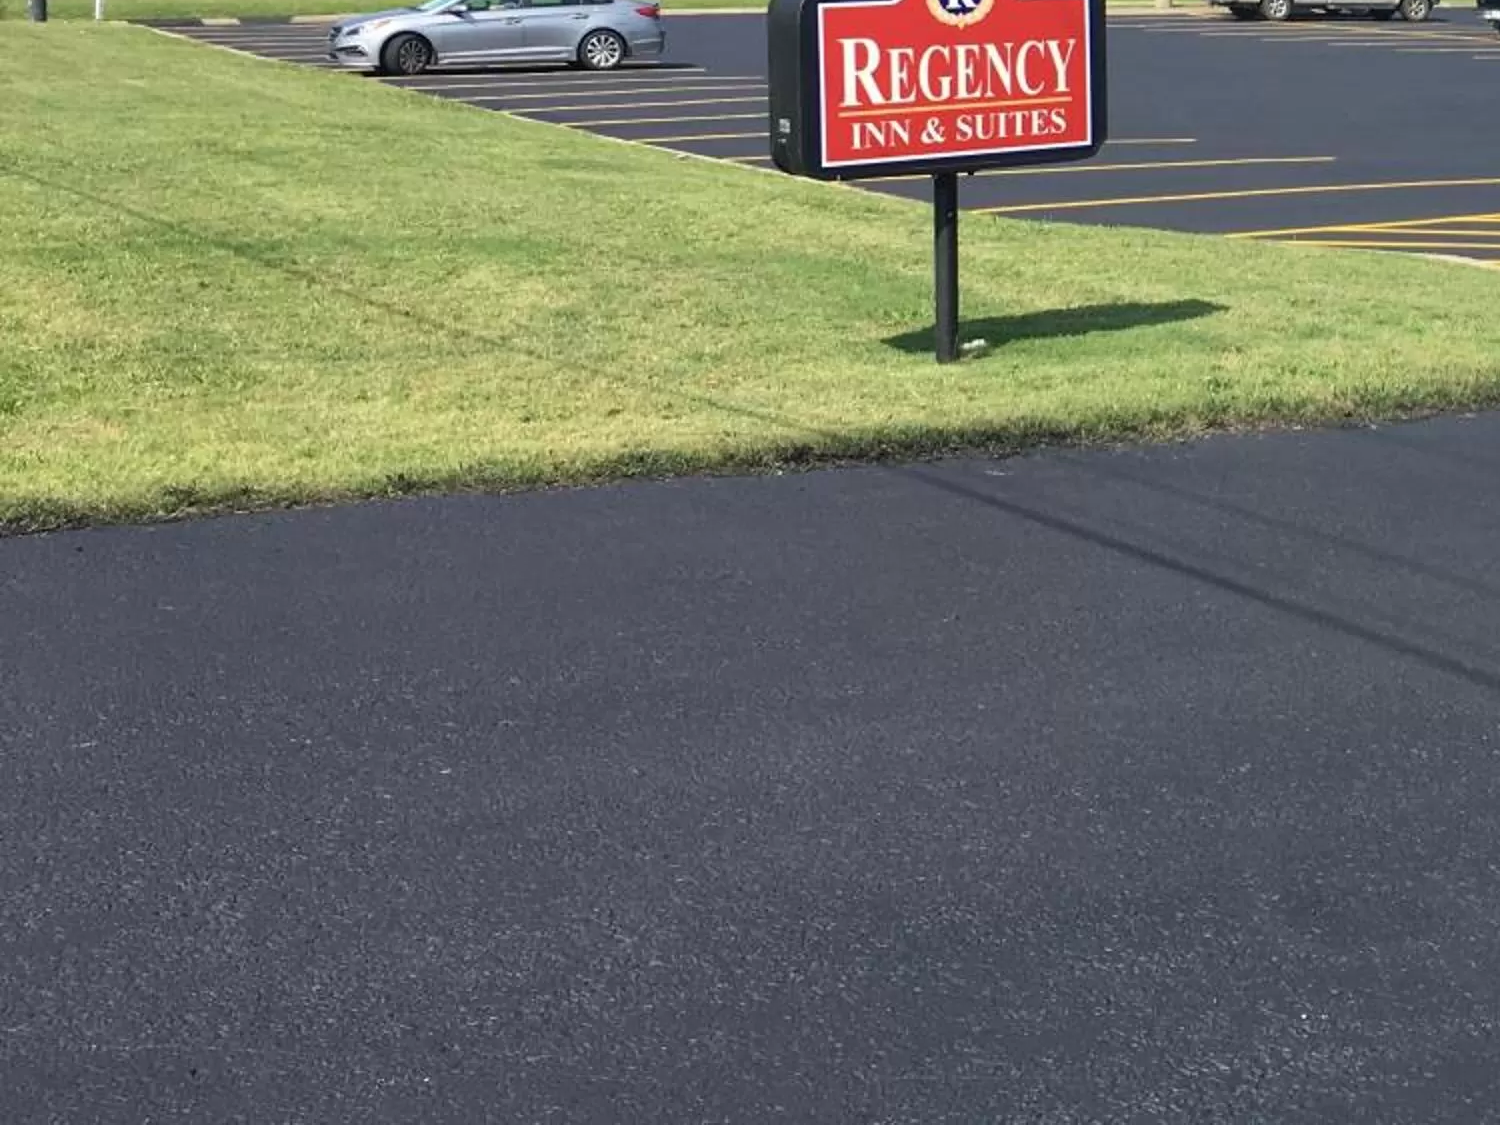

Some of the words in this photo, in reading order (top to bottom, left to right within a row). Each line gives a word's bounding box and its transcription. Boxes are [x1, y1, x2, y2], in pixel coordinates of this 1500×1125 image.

[837, 37, 1076, 107] REGENCY
[851, 119, 911, 150] INN
[920, 116, 946, 144] &
[955, 108, 1066, 142] SUITES
